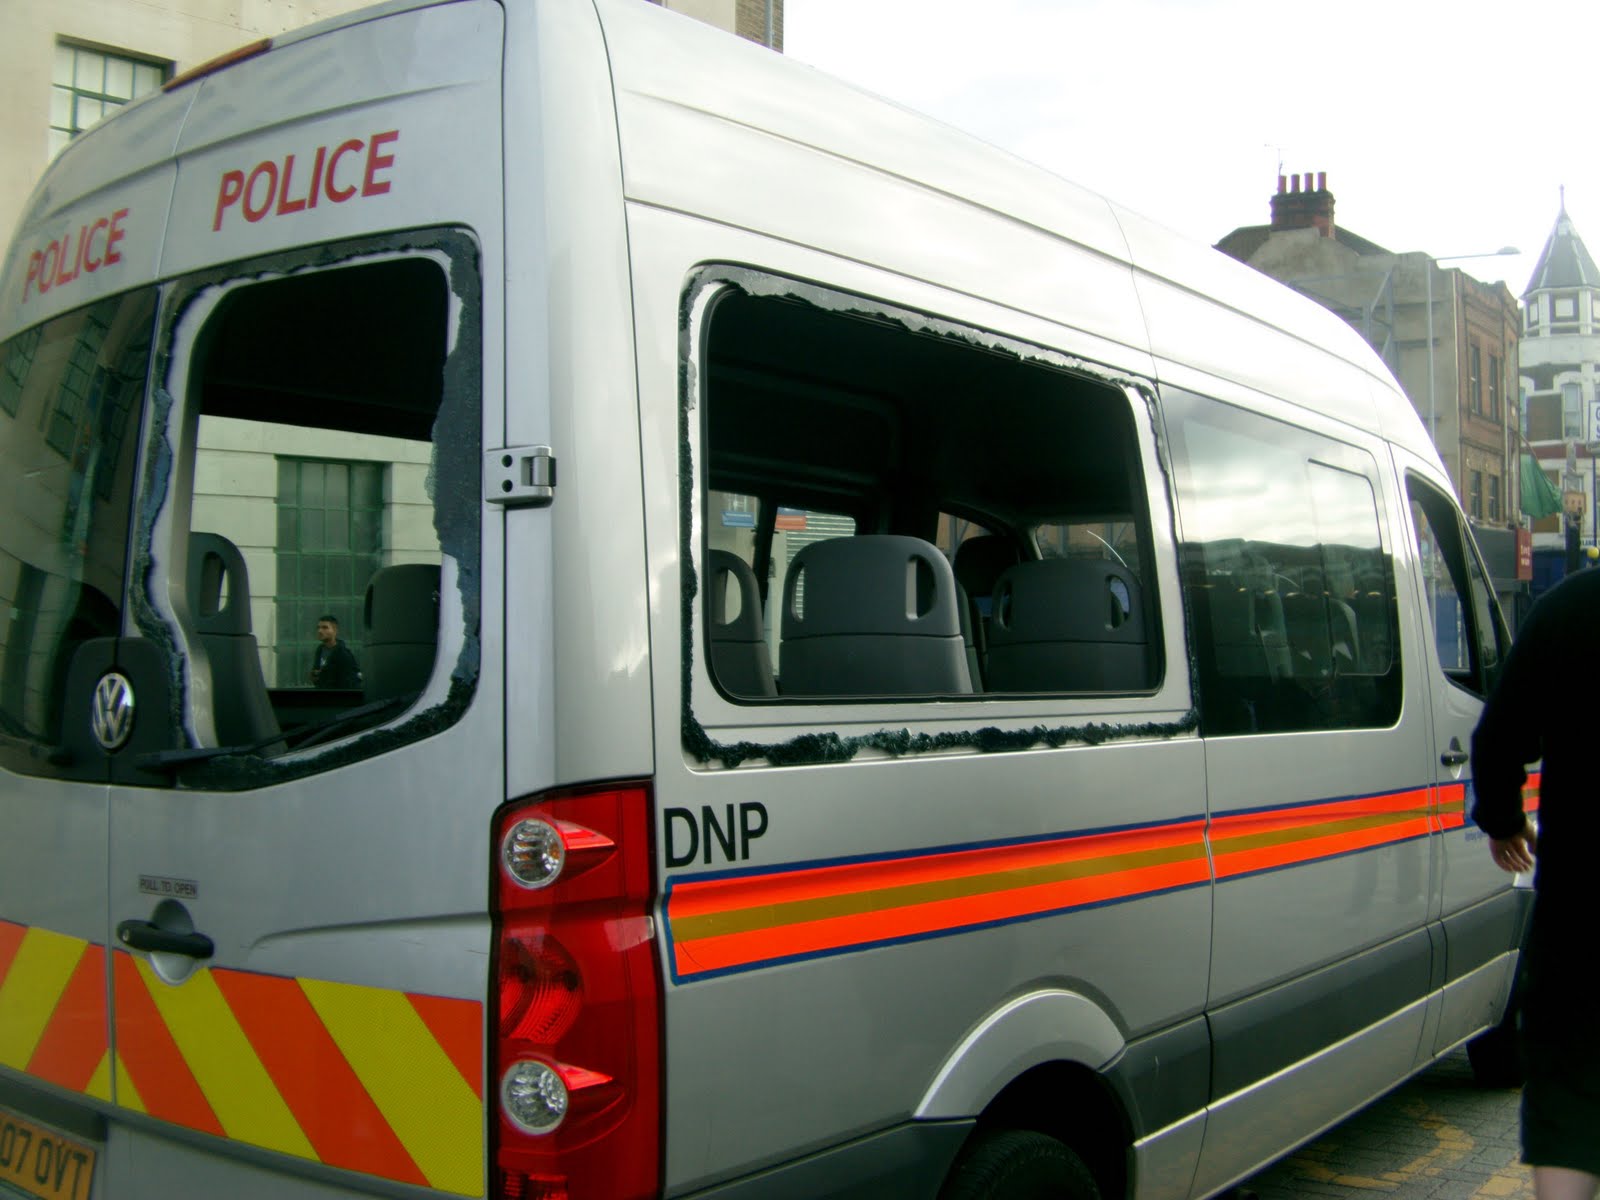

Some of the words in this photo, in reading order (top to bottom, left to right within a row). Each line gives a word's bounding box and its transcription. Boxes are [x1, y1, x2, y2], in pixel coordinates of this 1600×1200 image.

[212, 129, 400, 232] POLICE
[22, 208, 130, 304] POLICE
[663, 801, 769, 869] DNP
[140, 878, 158, 891] PULL
[161, 880, 172, 892] TO
[174, 882, 197, 897] OPEN
[35, 1137, 88, 1200] OVT
